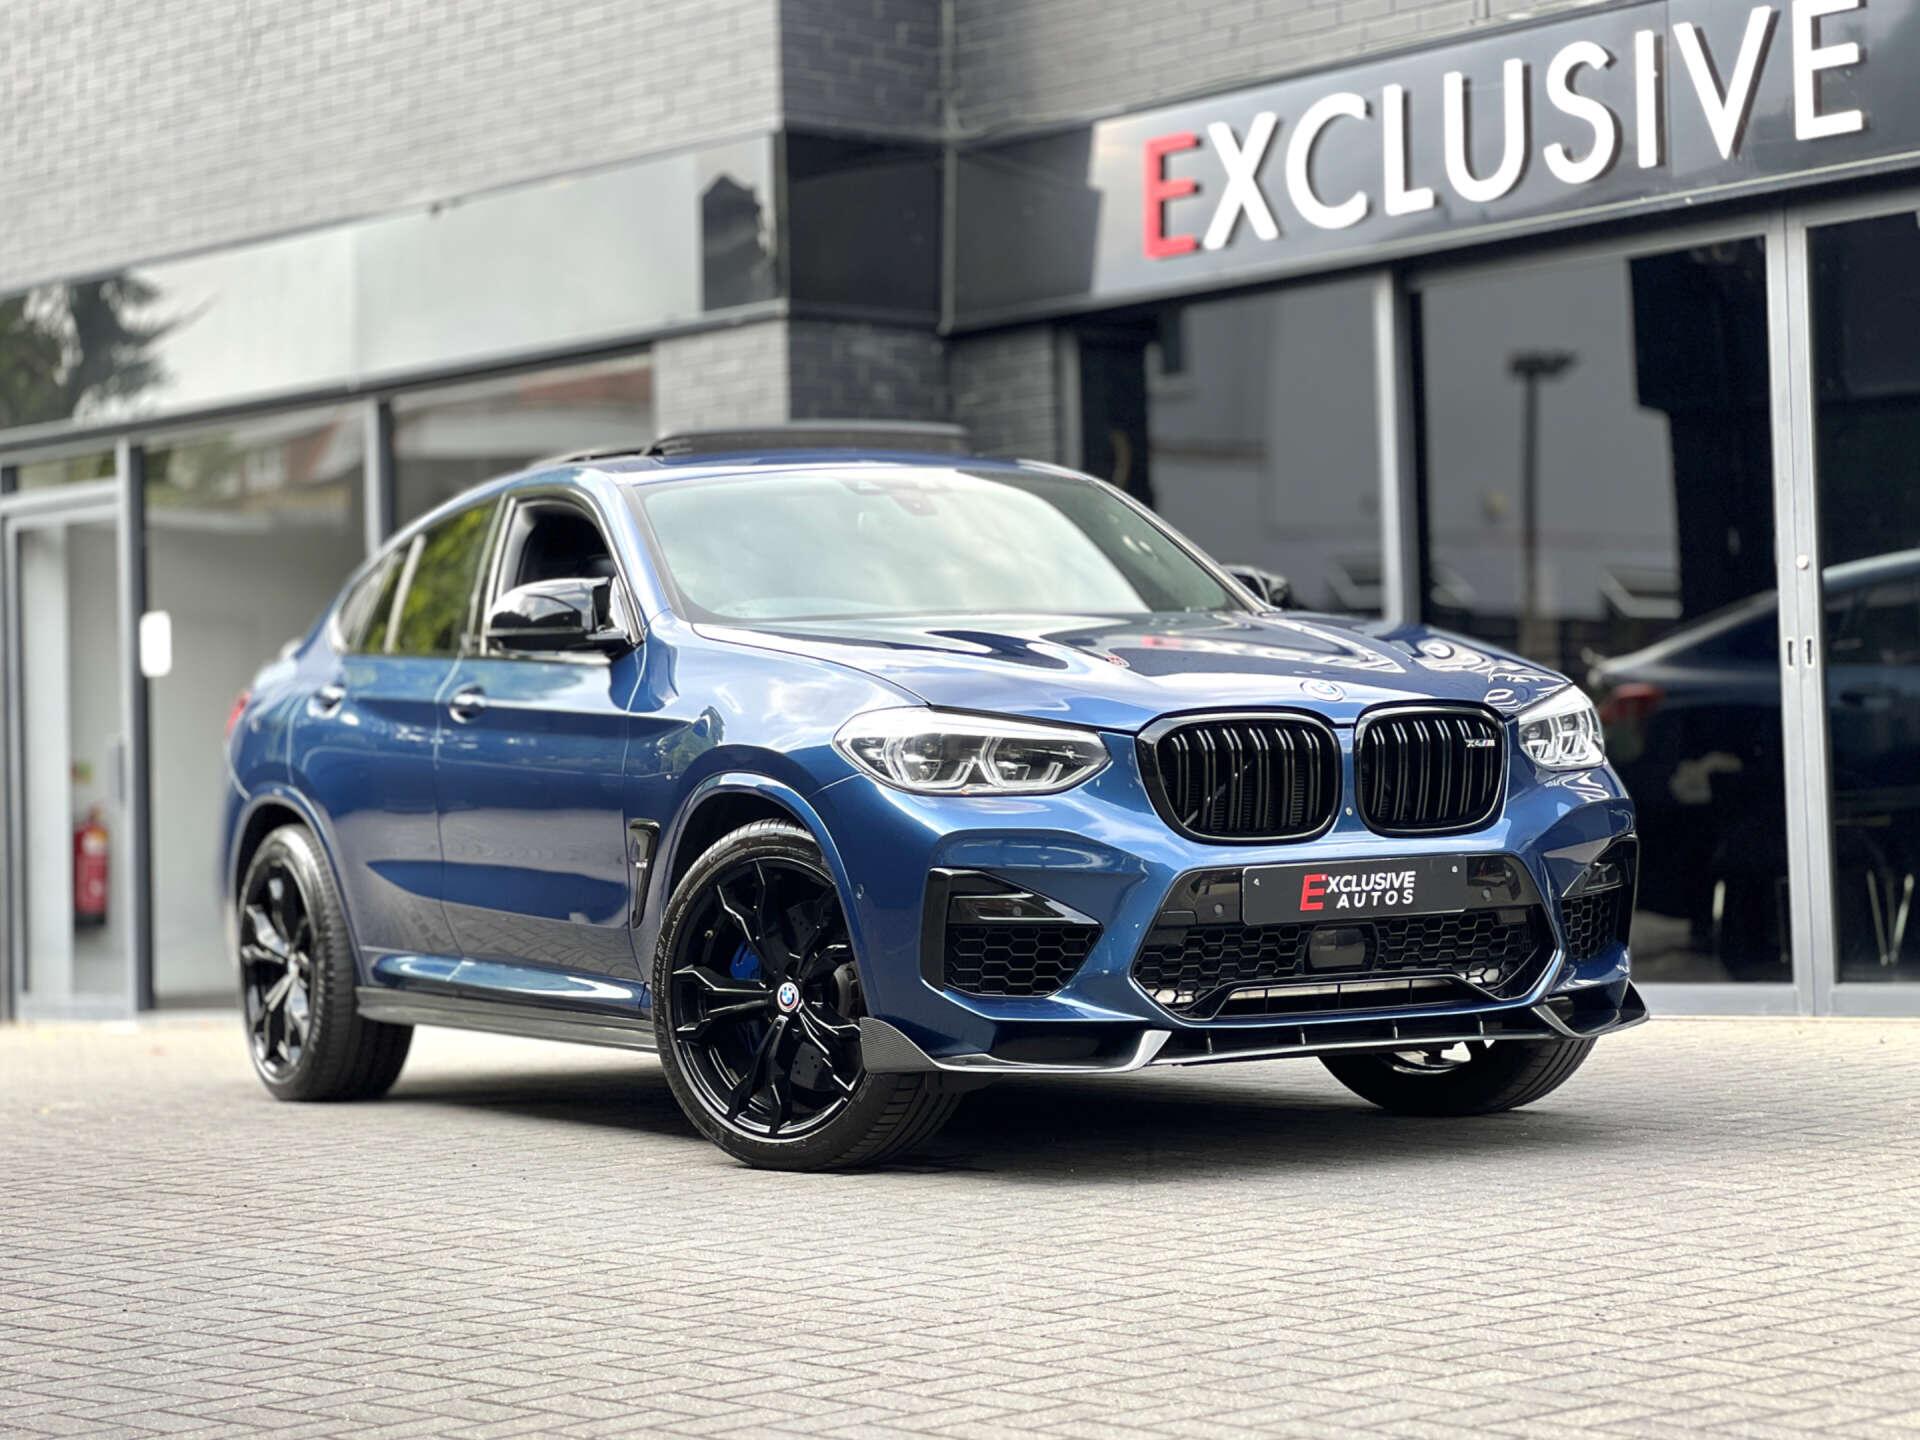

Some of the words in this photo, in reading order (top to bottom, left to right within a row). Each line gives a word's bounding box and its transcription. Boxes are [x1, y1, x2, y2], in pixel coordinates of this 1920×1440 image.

[1144, 0, 1865, 260] EXCLUSIVE
[1300, 871, 1416, 911] EXCLUSIVE
[1336, 889, 1414, 909] AUTOS
